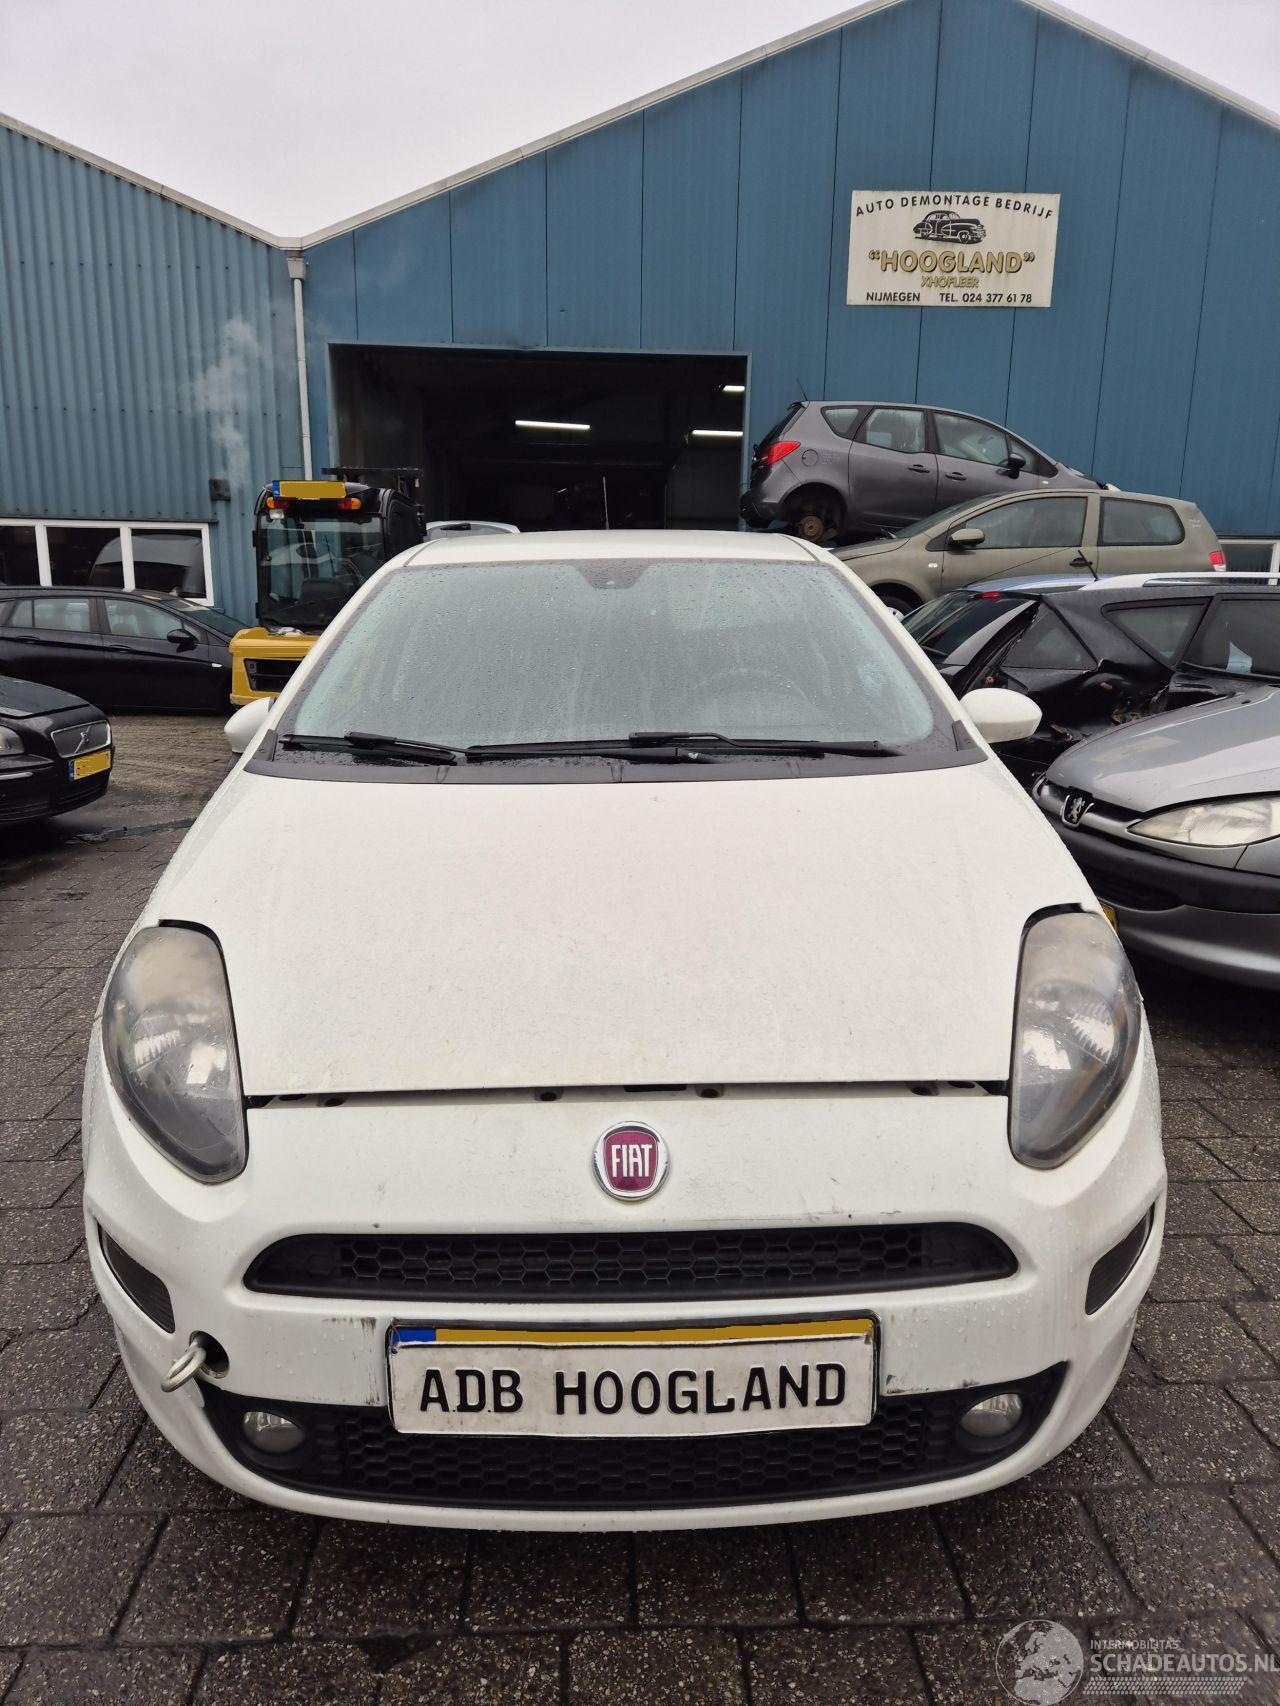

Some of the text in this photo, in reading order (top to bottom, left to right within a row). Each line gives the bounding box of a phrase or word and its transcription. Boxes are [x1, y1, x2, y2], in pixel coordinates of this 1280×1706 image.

[856, 194, 1053, 219] AUTO DEMONTAGE BEDRIJF
[866, 292, 1033, 304] NIJMEGEN TEL. 024 377 61 78
[611, 1144, 653, 1178] FIAT
[554, 1362, 847, 1416] HOOGLAND
